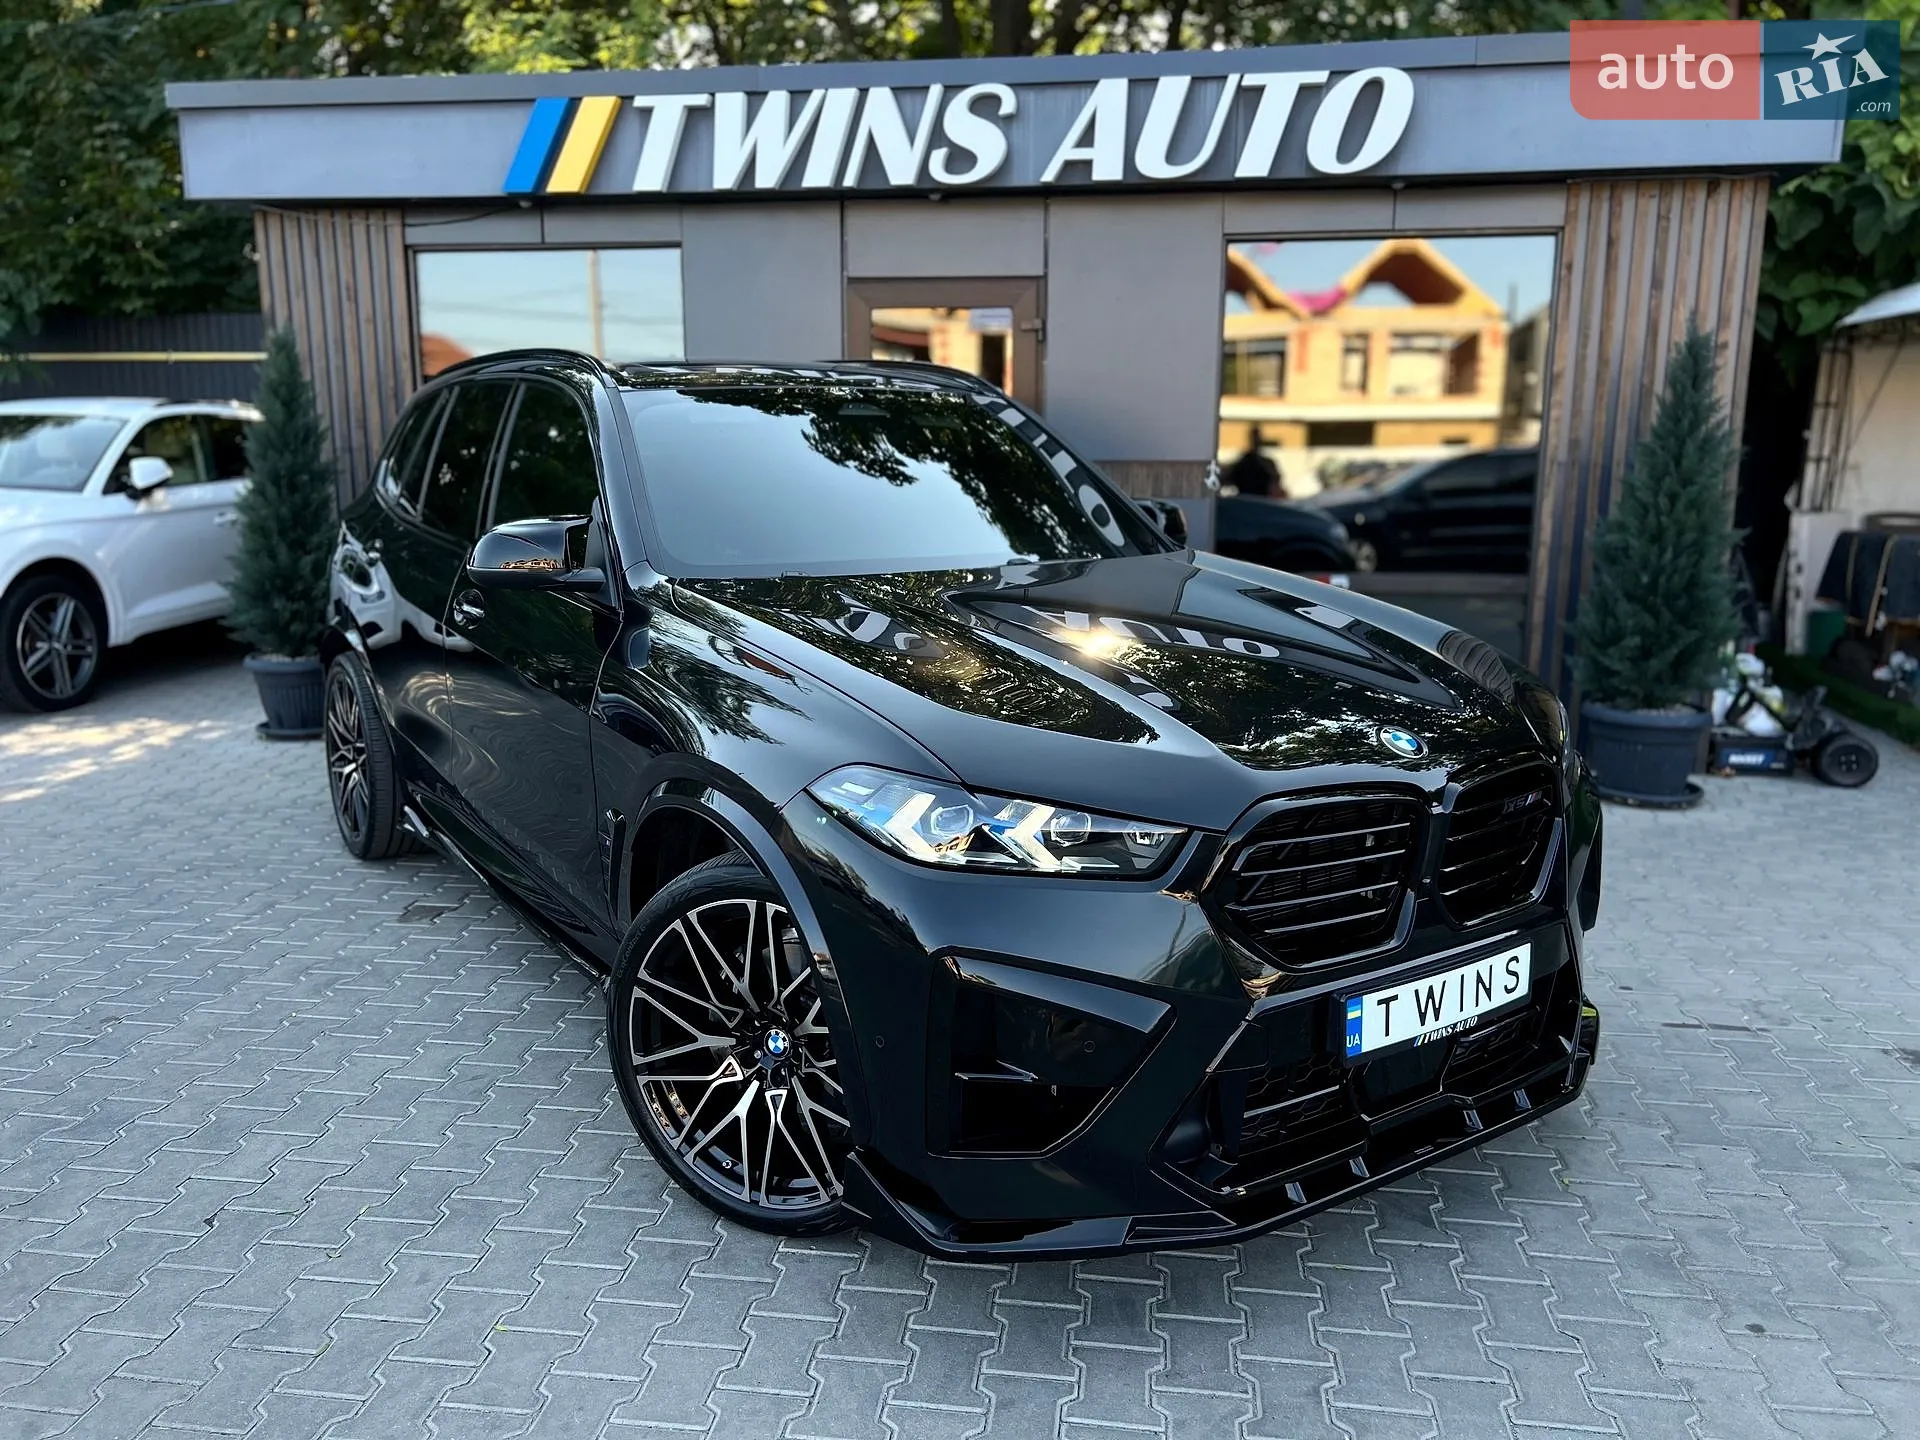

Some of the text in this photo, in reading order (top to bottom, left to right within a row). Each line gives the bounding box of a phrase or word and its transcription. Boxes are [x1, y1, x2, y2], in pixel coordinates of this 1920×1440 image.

[633, 67, 1414, 192] TWINS AUTO
[1346, 1032, 1361, 1048] UA
[1424, 1015, 1478, 1043] TWINS AUTO
